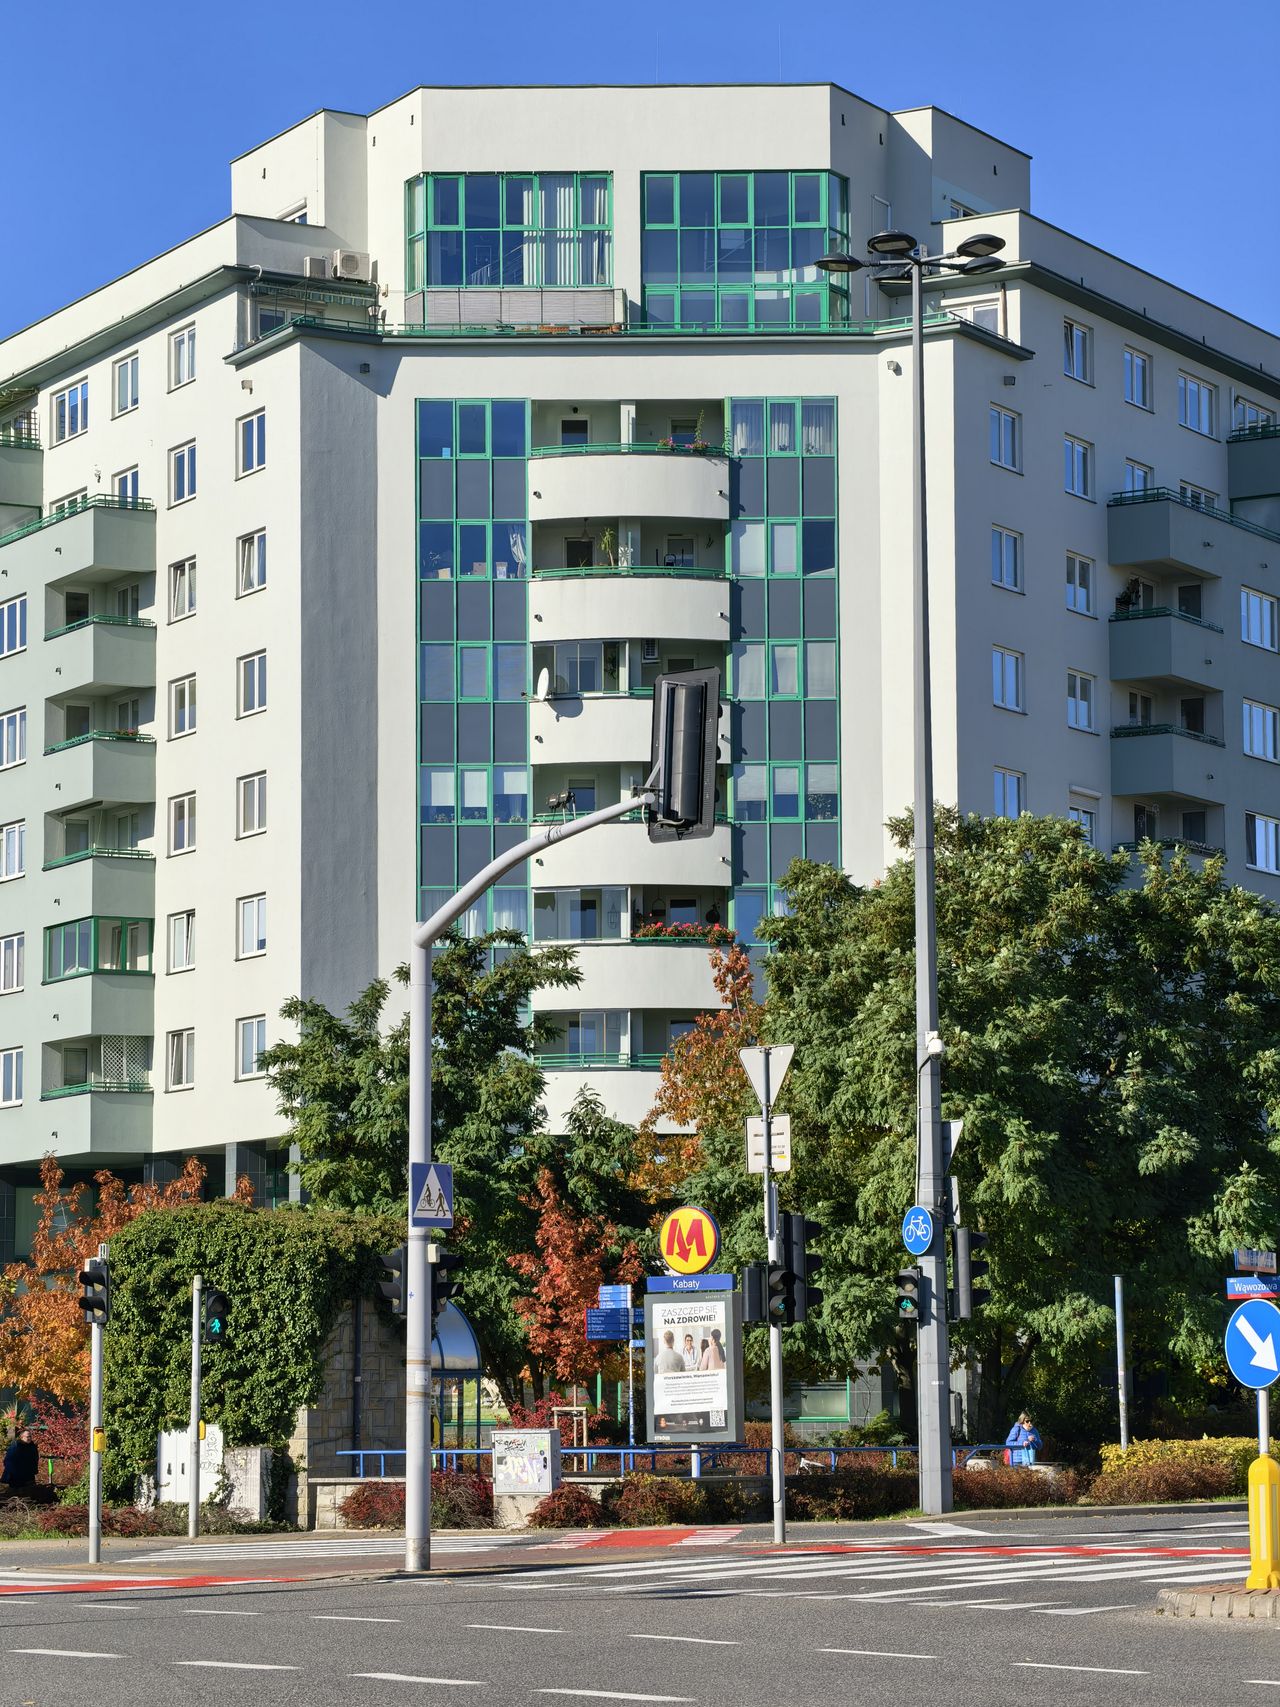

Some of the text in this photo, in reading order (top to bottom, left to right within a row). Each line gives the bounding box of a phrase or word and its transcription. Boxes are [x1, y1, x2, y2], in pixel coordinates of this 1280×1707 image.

[672, 1280, 700, 1289] Kabaty
[1234, 1283, 1277, 1293] Wąwozowa
[661, 1304, 718, 1318] ZASZCZEP SIĘ
[663, 1314, 716, 1325] NA ZDROWIE!
